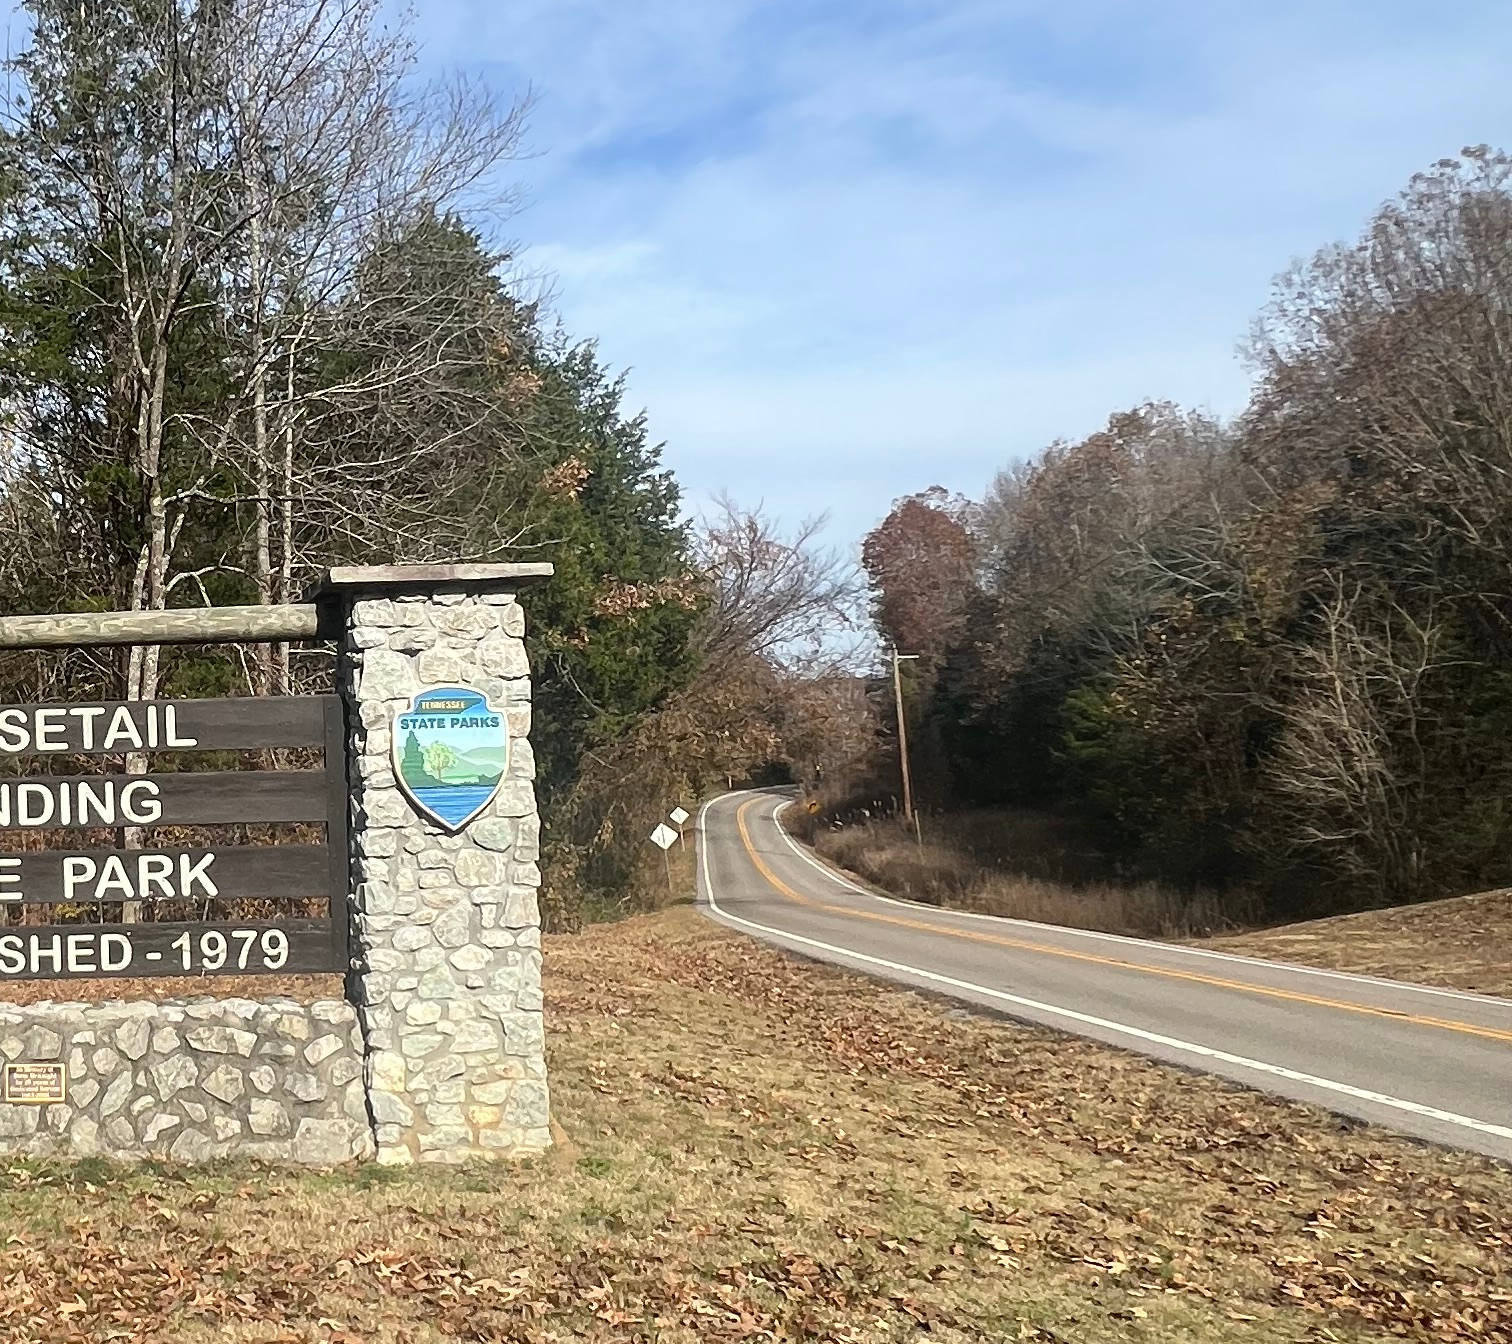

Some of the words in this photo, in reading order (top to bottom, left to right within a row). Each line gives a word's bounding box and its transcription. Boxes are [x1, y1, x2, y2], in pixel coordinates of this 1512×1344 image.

[400, 717, 446, 730] STATE
[450, 716, 500, 729] PARKS
[62, 852, 220, 899] PARK
